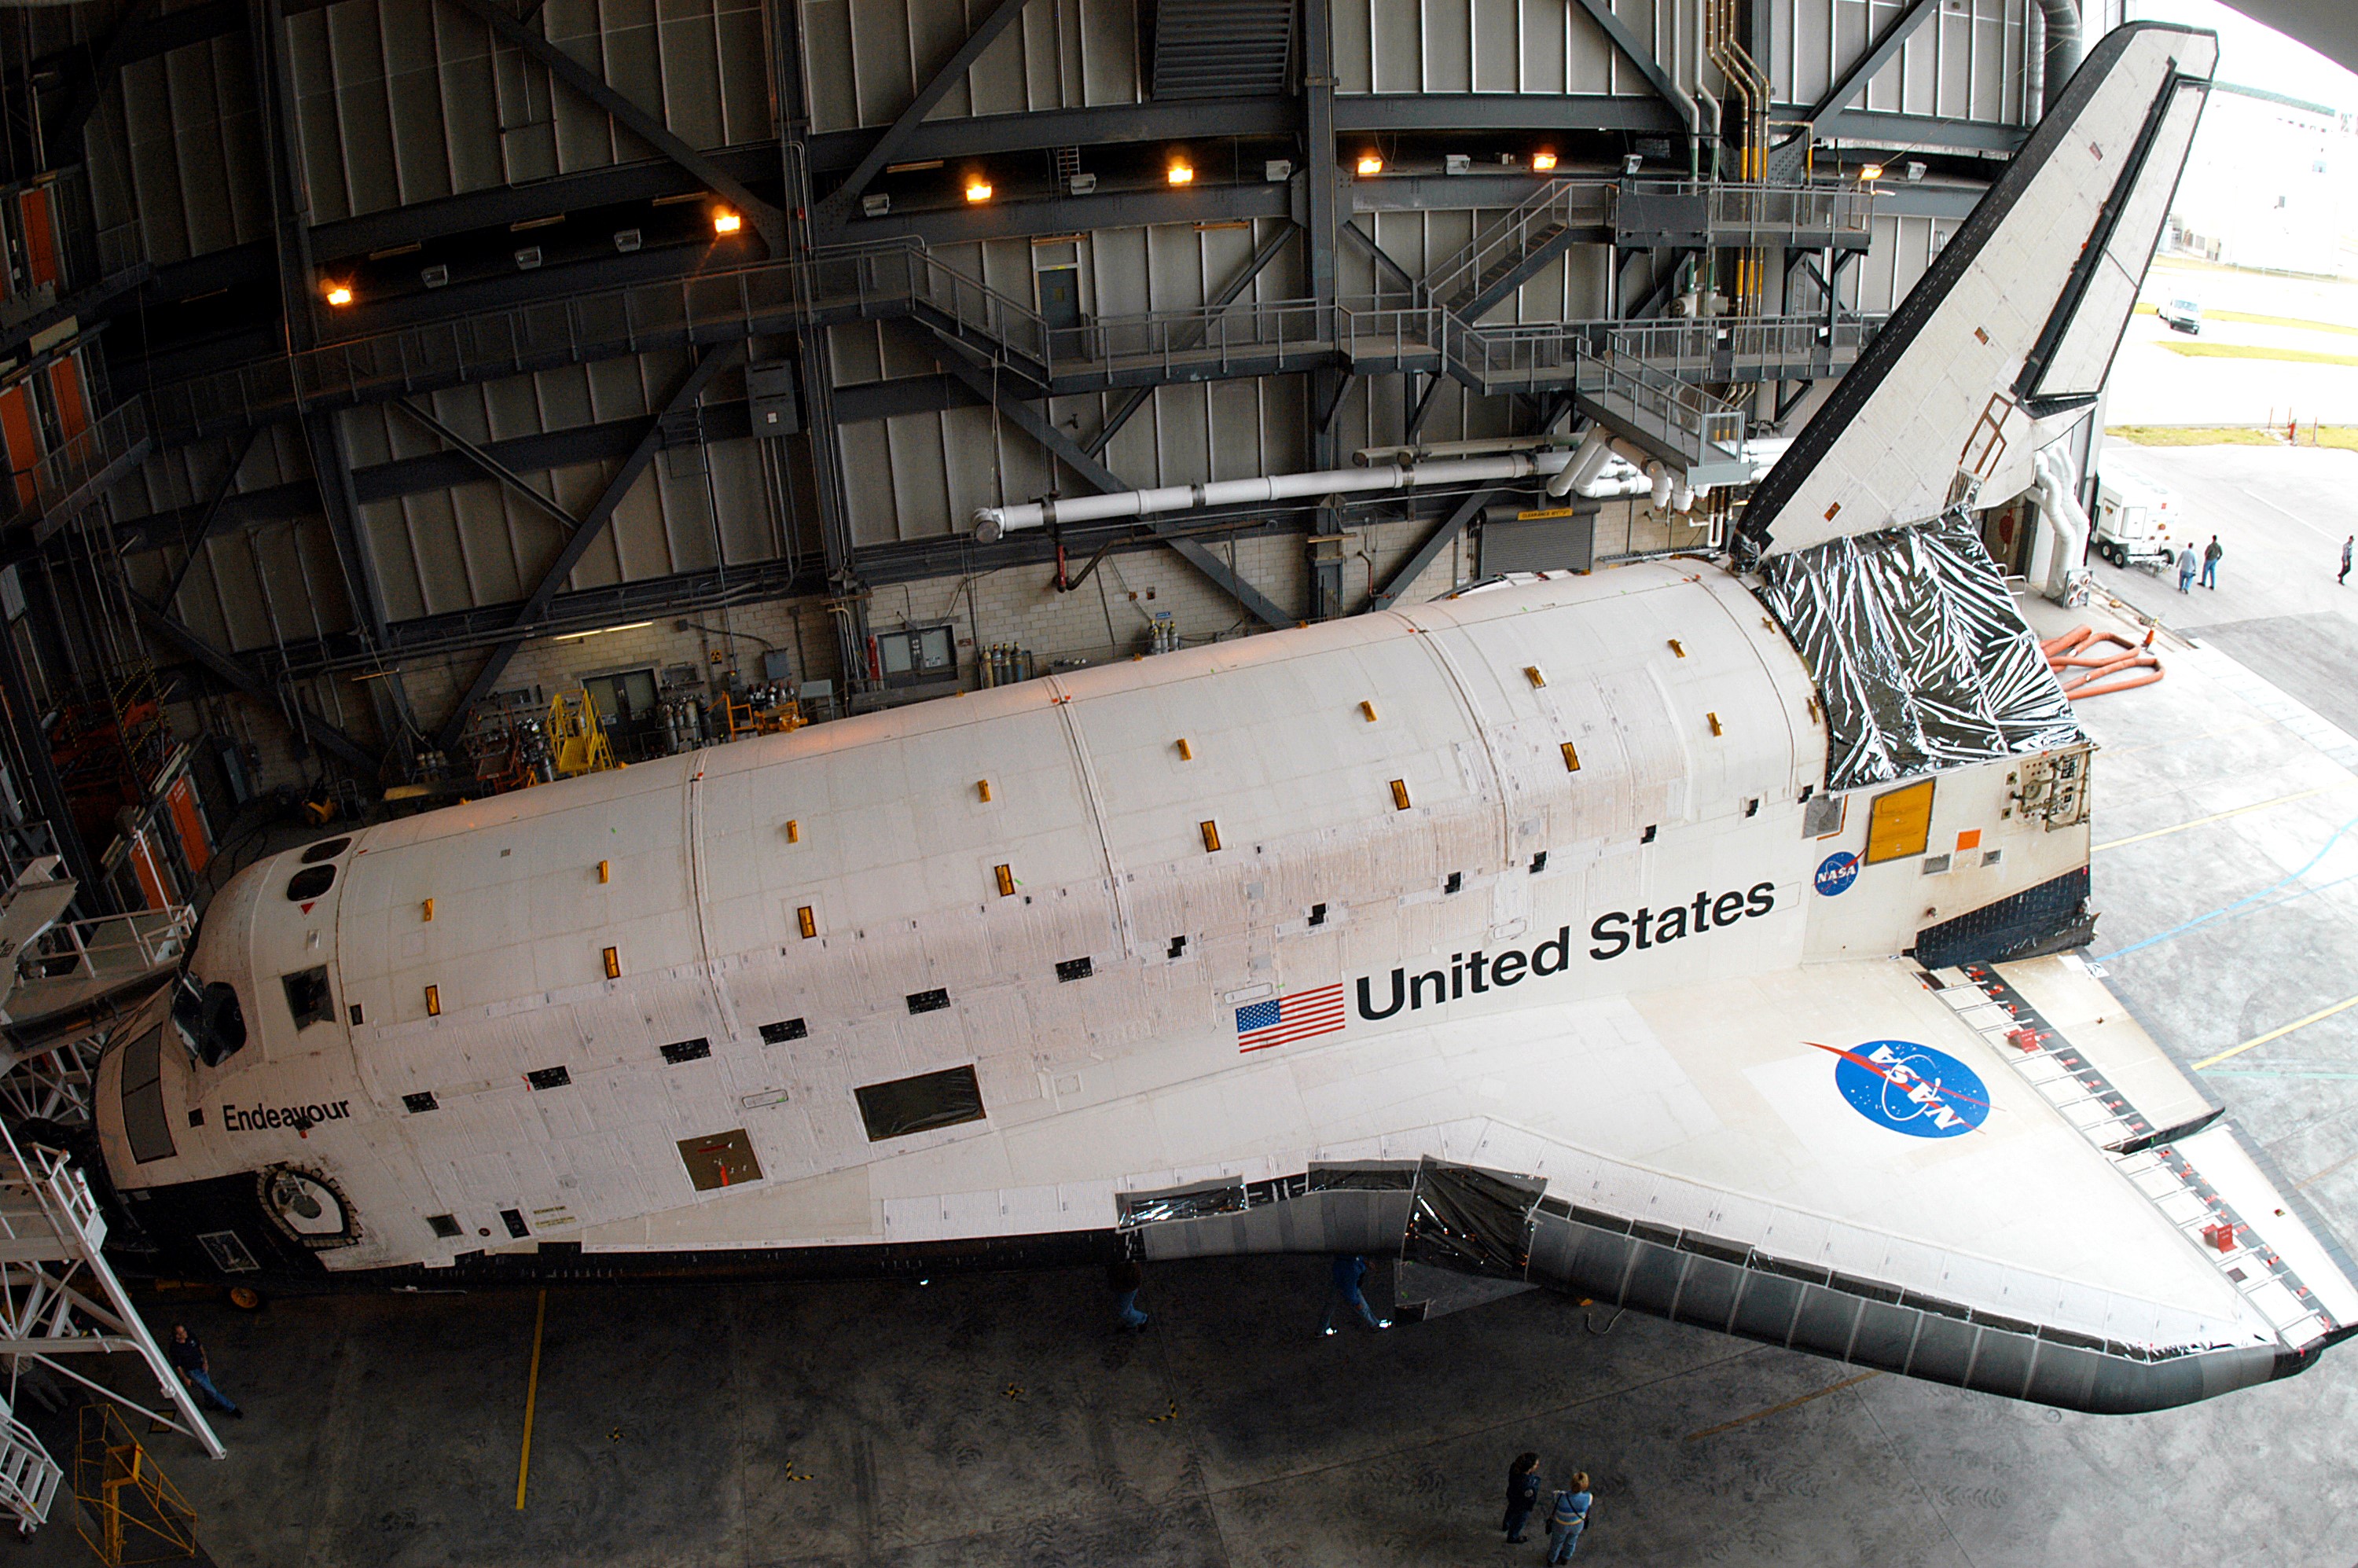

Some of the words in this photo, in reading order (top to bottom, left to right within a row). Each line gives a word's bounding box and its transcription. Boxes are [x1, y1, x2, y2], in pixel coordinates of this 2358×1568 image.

[1817, 865, 1857, 883] NASA
[1357, 925, 1570, 1021] United
[1589, 881, 1775, 960] States
[222, 1100, 351, 1131] Endeavour
[1868, 1044, 1965, 1130] NASA
